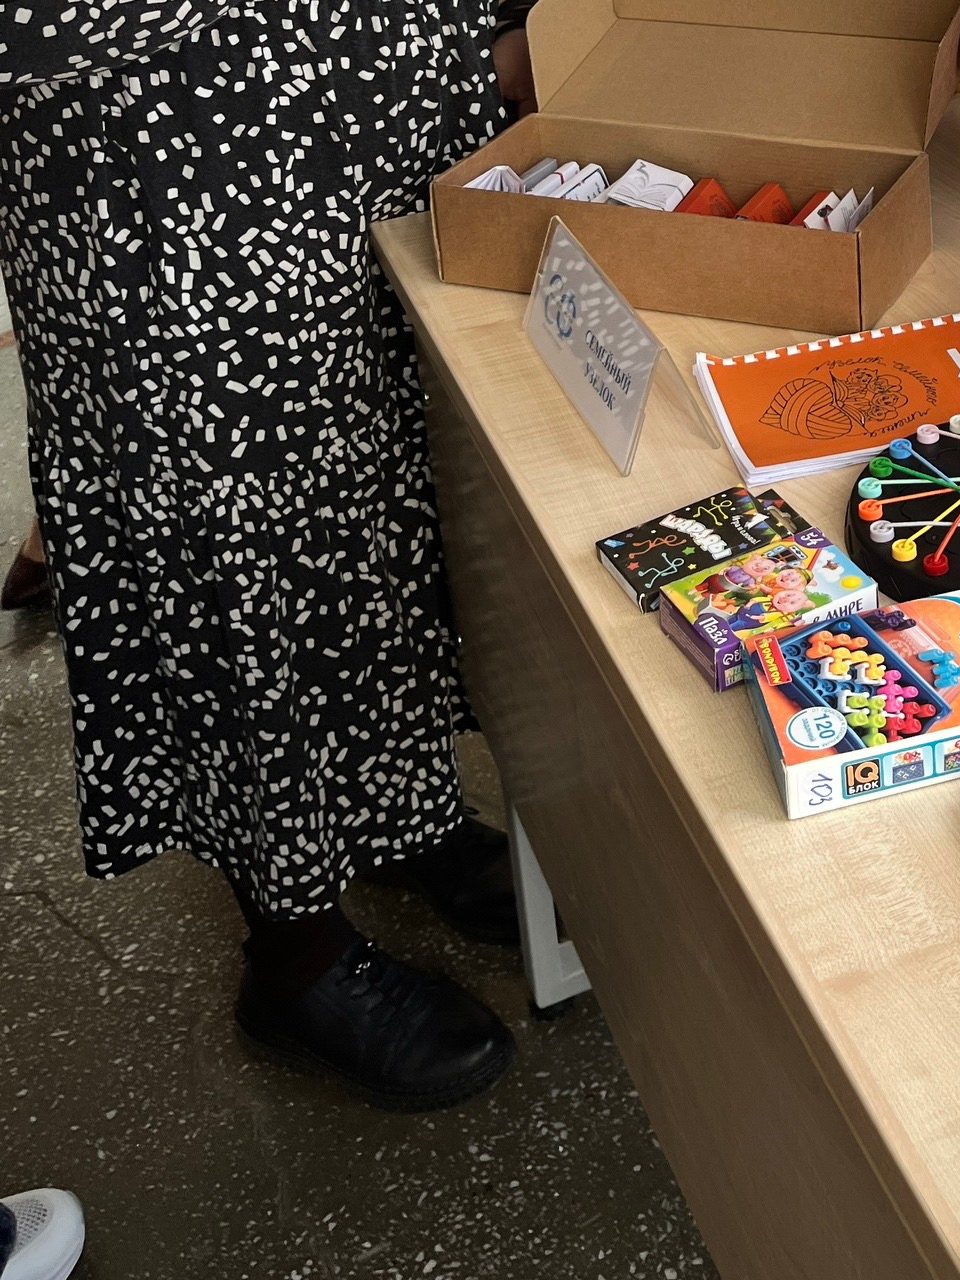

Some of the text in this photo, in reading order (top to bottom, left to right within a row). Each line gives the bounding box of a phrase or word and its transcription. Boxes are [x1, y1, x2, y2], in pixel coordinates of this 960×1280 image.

[585, 330, 632, 395] СЕМЕЙНЫЙ
[800, 531, 825, 549] 54
[813, 713, 836, 739] 120
[847, 761, 880, 786] IQ
[848, 781, 879, 795] БЛОК
